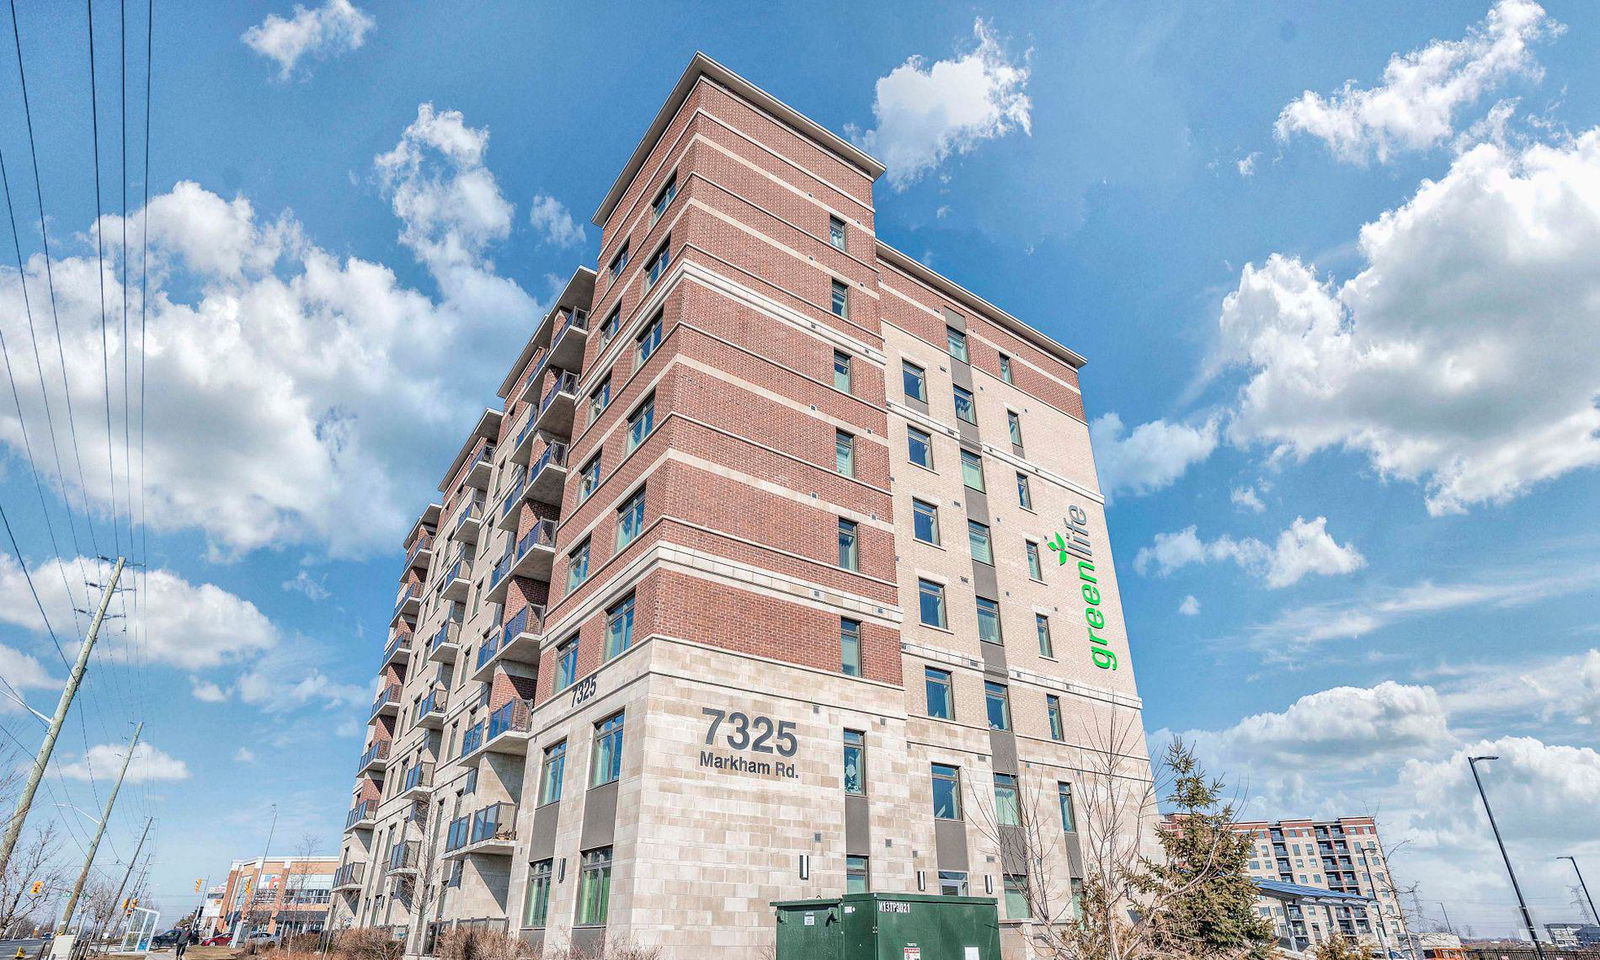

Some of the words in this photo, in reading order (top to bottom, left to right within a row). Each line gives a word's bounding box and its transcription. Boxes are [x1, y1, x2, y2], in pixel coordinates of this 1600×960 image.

[571, 673, 597, 707] 7325
[702, 707, 798, 757] 7325
[700, 751, 771, 775] Markham
[775, 761, 799, 779] Rd.
